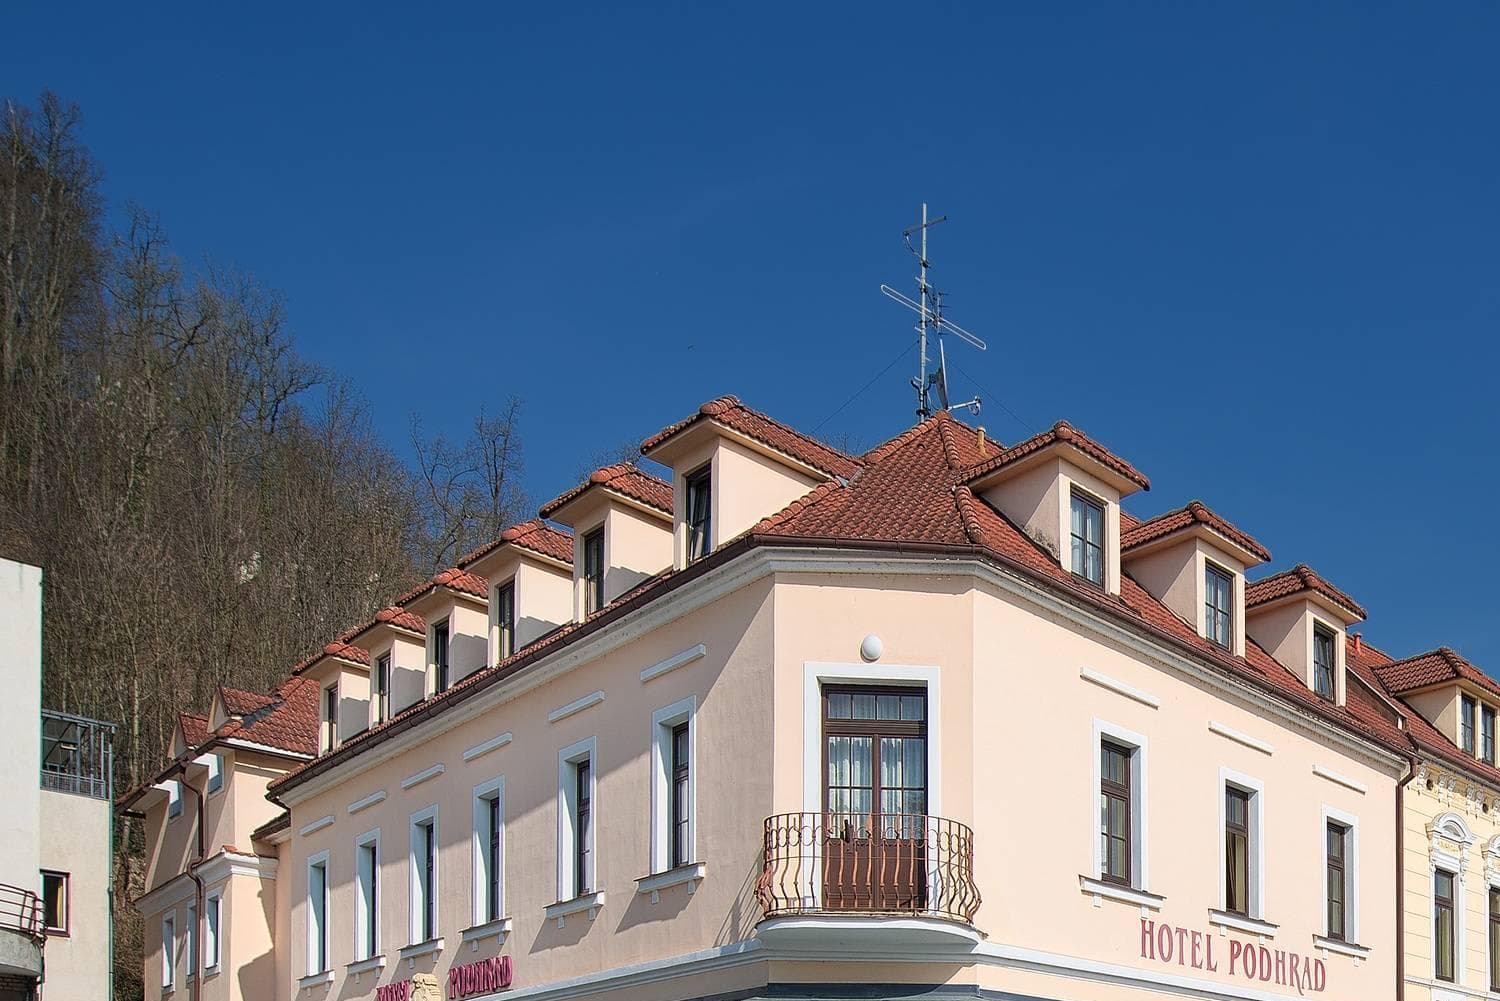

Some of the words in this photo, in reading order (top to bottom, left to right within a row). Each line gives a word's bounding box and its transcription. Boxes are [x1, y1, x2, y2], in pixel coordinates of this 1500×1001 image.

[449, 955, 513, 1000] PODHRAD
[1140, 918, 1218, 972] HOTEL
[1229, 939, 1327, 996] PODHRAD
